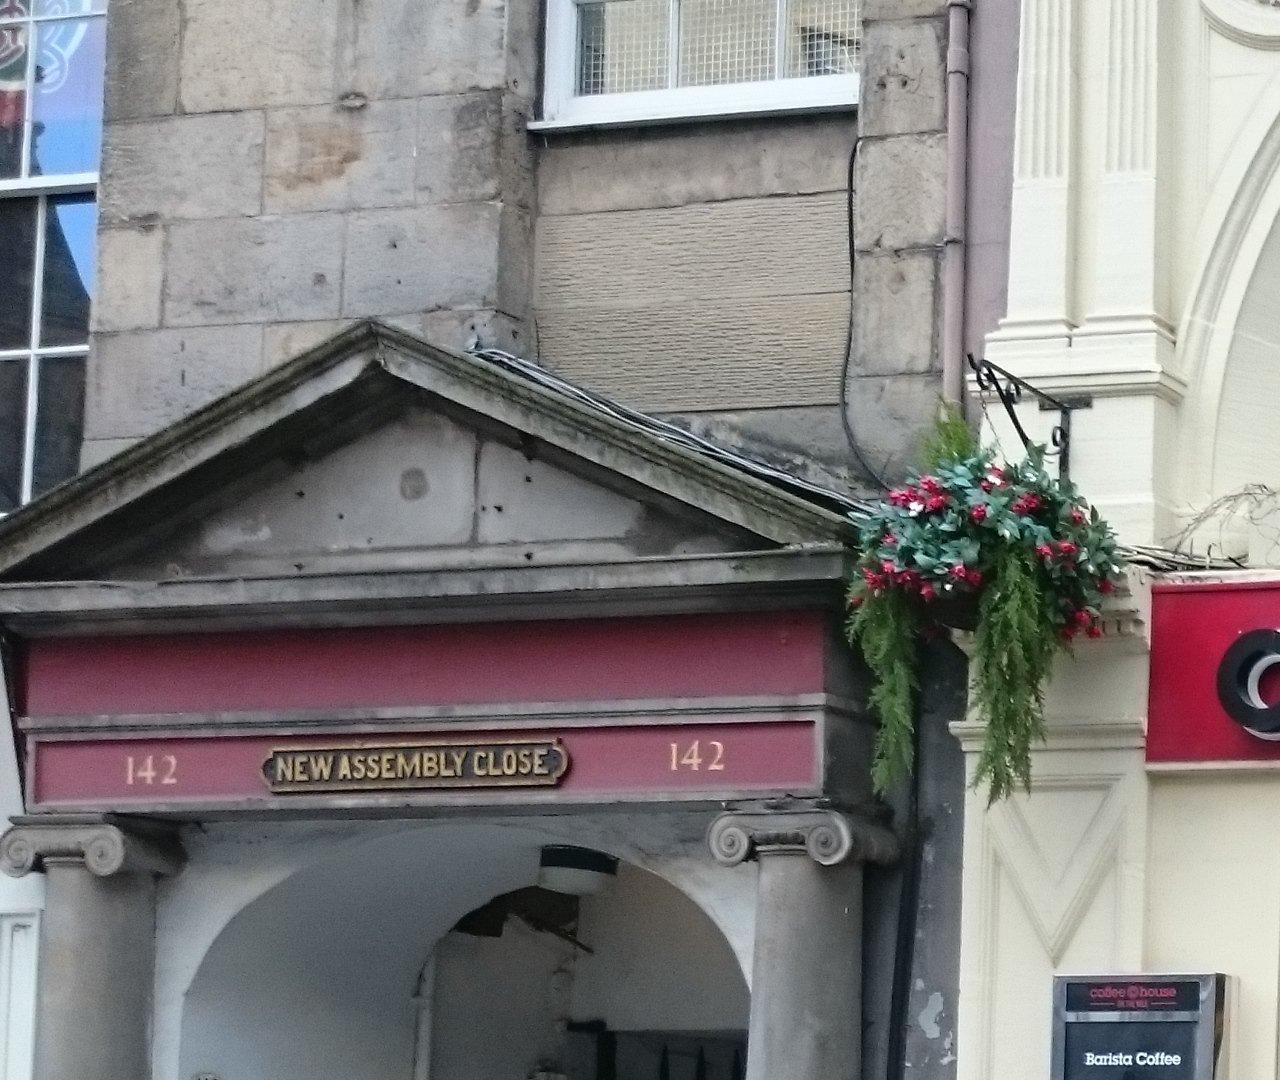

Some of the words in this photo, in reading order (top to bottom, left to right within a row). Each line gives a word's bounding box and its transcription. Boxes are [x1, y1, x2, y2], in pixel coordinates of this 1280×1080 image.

[126, 755, 178, 785] 142
[276, 754, 334, 783] NEW
[338, 751, 468, 781] ASSEMBLY
[472, 748, 550, 777] CLOSE
[669, 739, 726, 773] 142
[1140, 984, 1177, 997] house
[1085, 1052, 1132, 1066] Barista
[1136, 1052, 1181, 1066] Coffee
